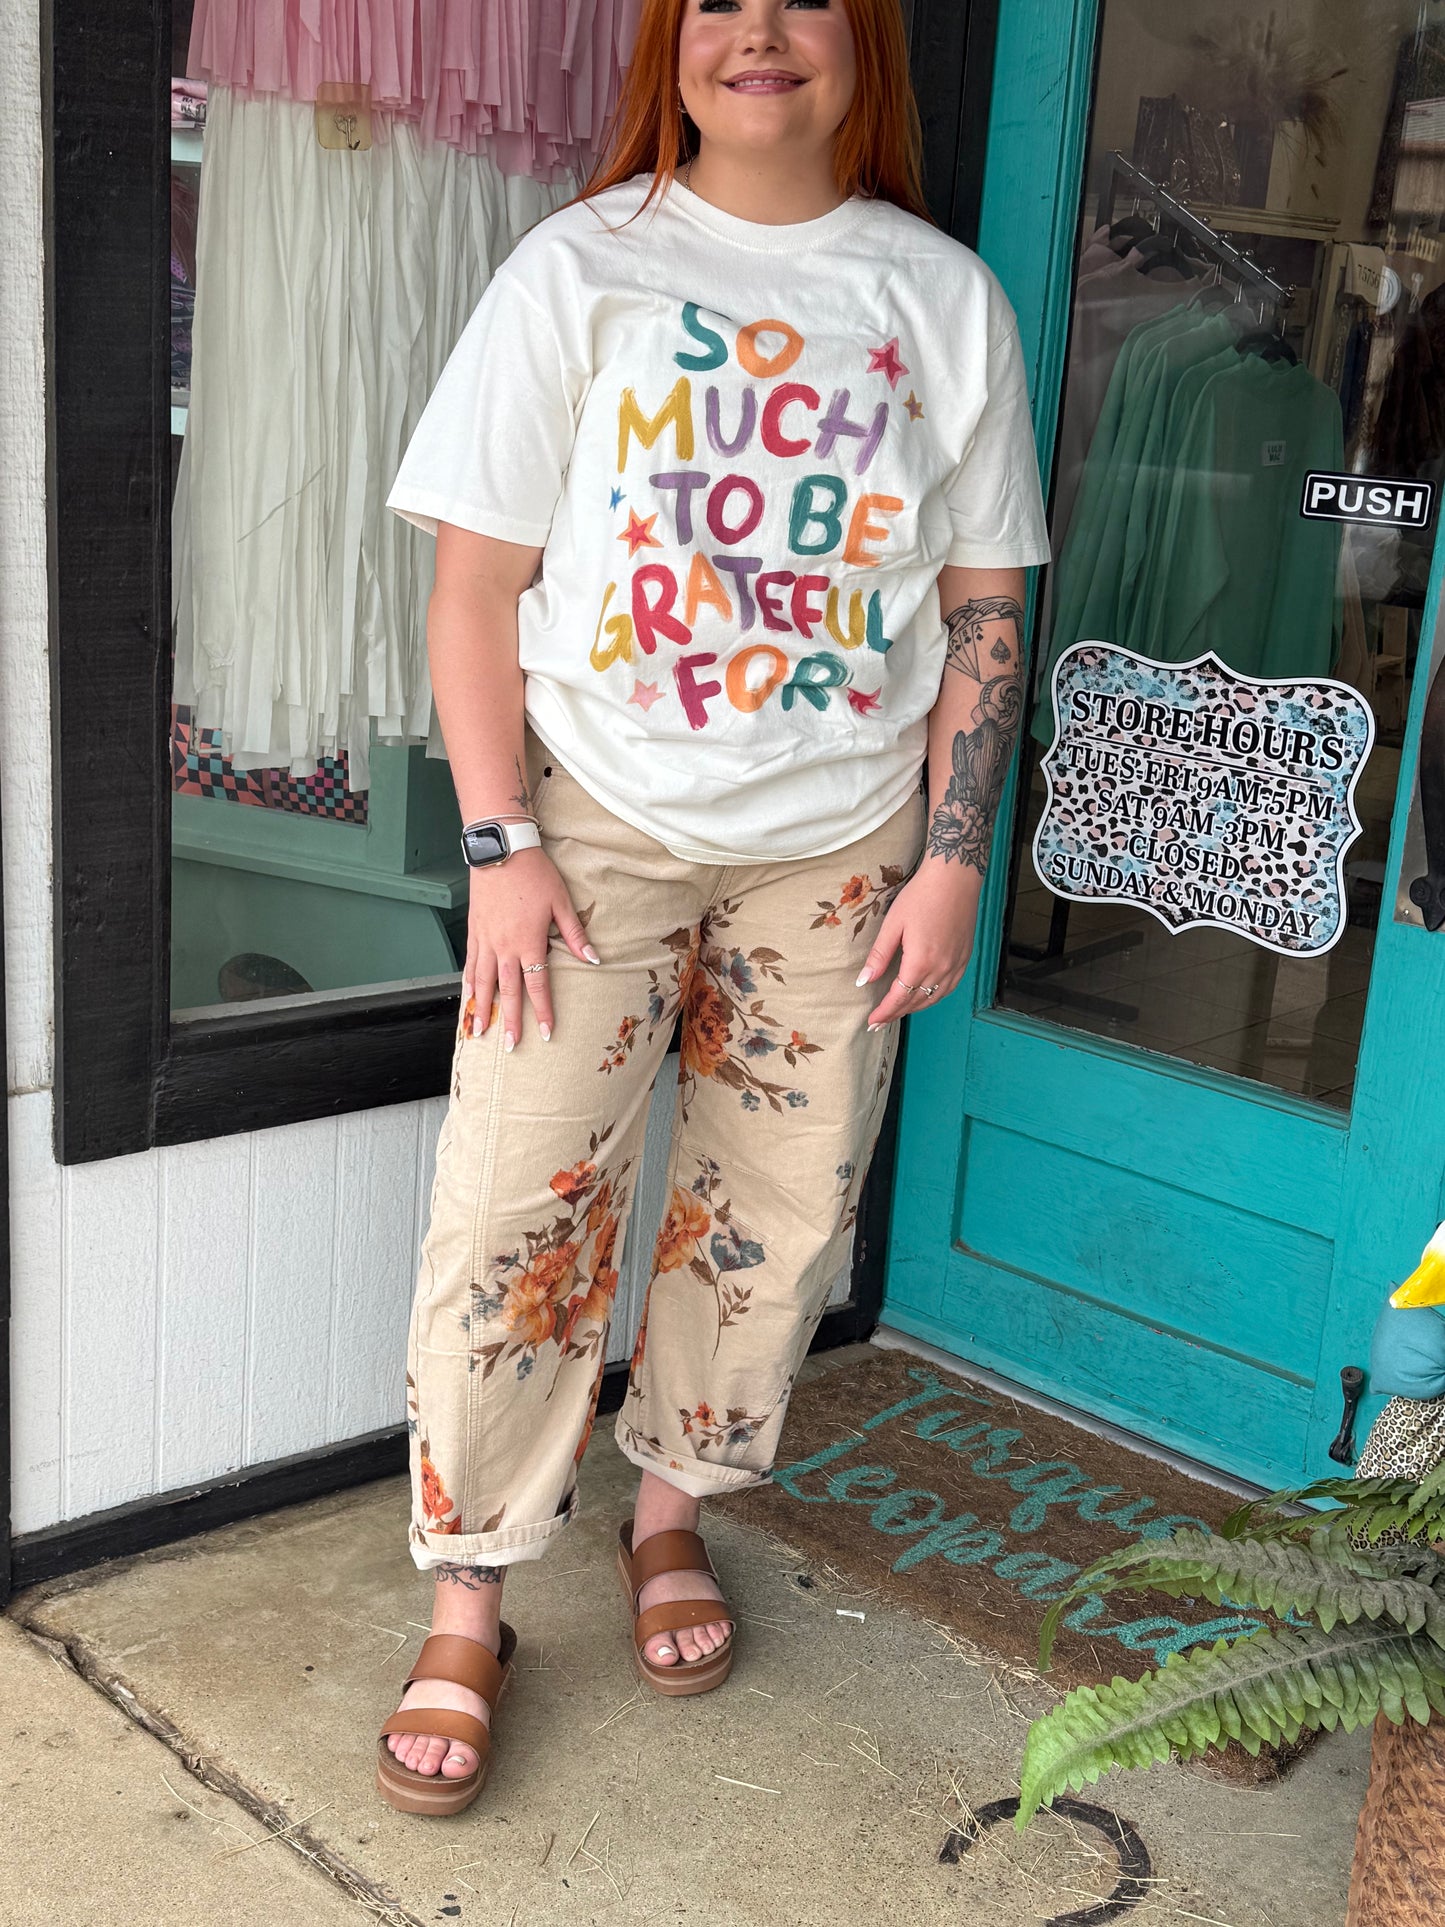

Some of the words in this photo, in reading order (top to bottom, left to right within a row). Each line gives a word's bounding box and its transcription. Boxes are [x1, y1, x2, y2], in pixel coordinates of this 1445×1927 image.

[673, 301, 805, 378] SO
[617, 376, 889, 475] MUCH
[649, 470, 765, 546] TO
[788, 474, 904, 567] BE
[1310, 482, 1423, 519] PUSH
[589, 551, 893, 672] GRATEFUL
[673, 643, 853, 731] FOR
[1070, 690, 1192, 743] STORE
[1201, 714, 1345, 770] HOURS
[1099, 790, 1148, 820] SAT
[1153, 805, 1285, 851] 9AM-3PM
[1199, 776, 1334, 821] 9AM-5PM
[1051, 854, 1157, 899] SUNDAY
[1162, 882, 1183, 905] &
[1191, 890, 1320, 938] MONDAY
[1129, 835, 1241, 879] CLOSED
